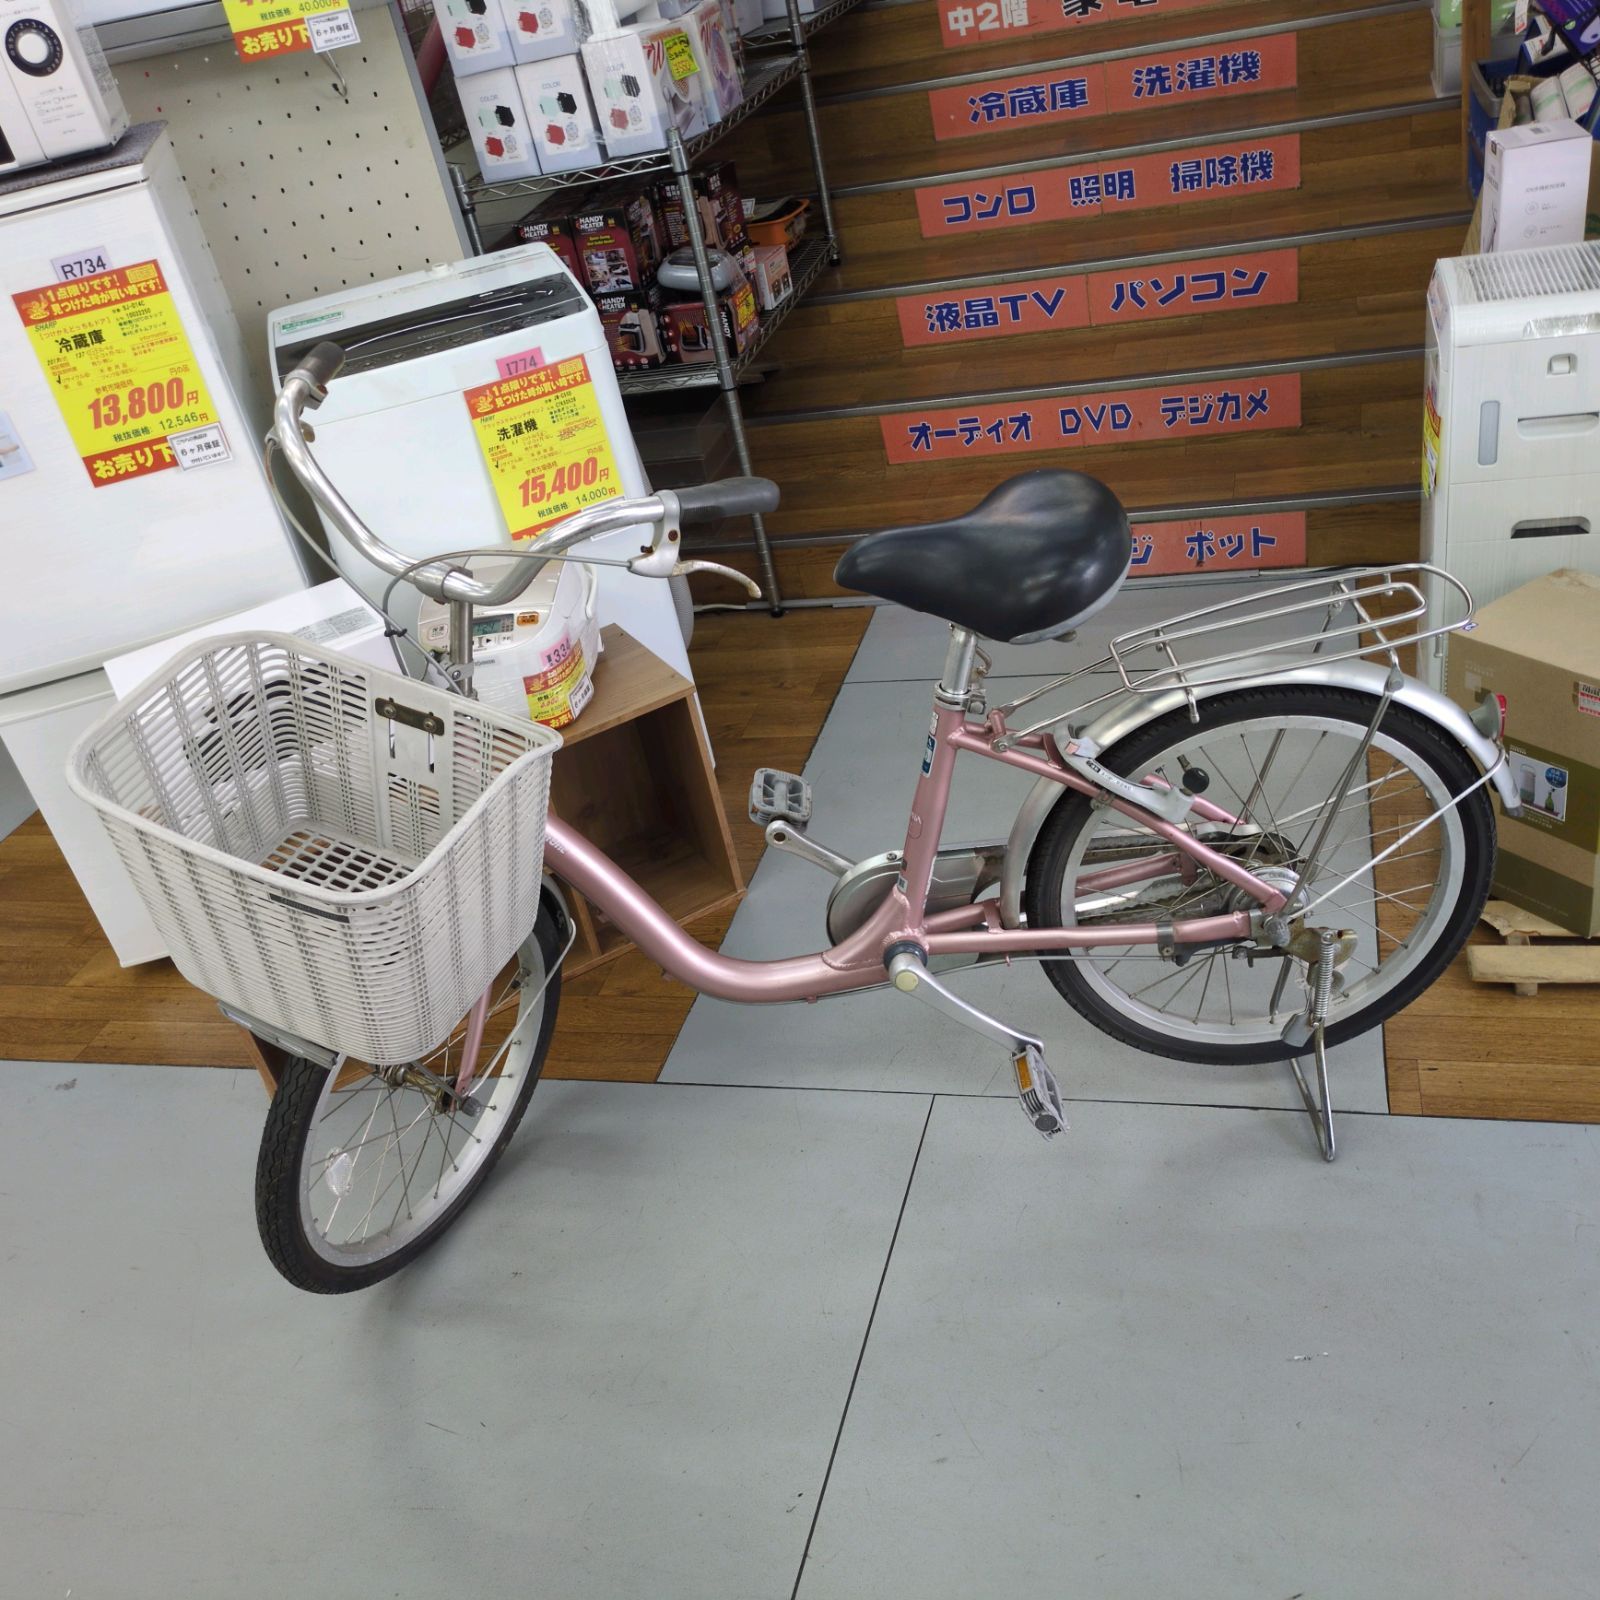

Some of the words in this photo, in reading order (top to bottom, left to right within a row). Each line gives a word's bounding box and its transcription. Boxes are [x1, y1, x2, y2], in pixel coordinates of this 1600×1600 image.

[947, 0, 1029, 36] 中2階
[968, 77, 1089, 123] 冷蔵庫
[1132, 51, 1261, 98] 洗濯機
[943, 185, 1037, 224] コンロ
[1069, 169, 1136, 207] 照明
[1170, 149, 1275, 193] 掃除機
[524, 223, 548, 232] HANDY
[579, 216, 603, 224] HANDY
[61, 255, 107, 280] R734
[924, 288, 1066, 333] 液晶TV
[1110, 267, 1270, 313] パソコン
[720, 311, 731, 338] HANDY
[55, 330, 106, 353] 冷蔵庫
[497, 418, 539, 441] 洗濯機
[908, 411, 1032, 452] オーディオ
[1059, 403, 1132, 436] DVD
[1160, 389, 1270, 428] デジカメ
[1185, 527, 1277, 561] ポット
